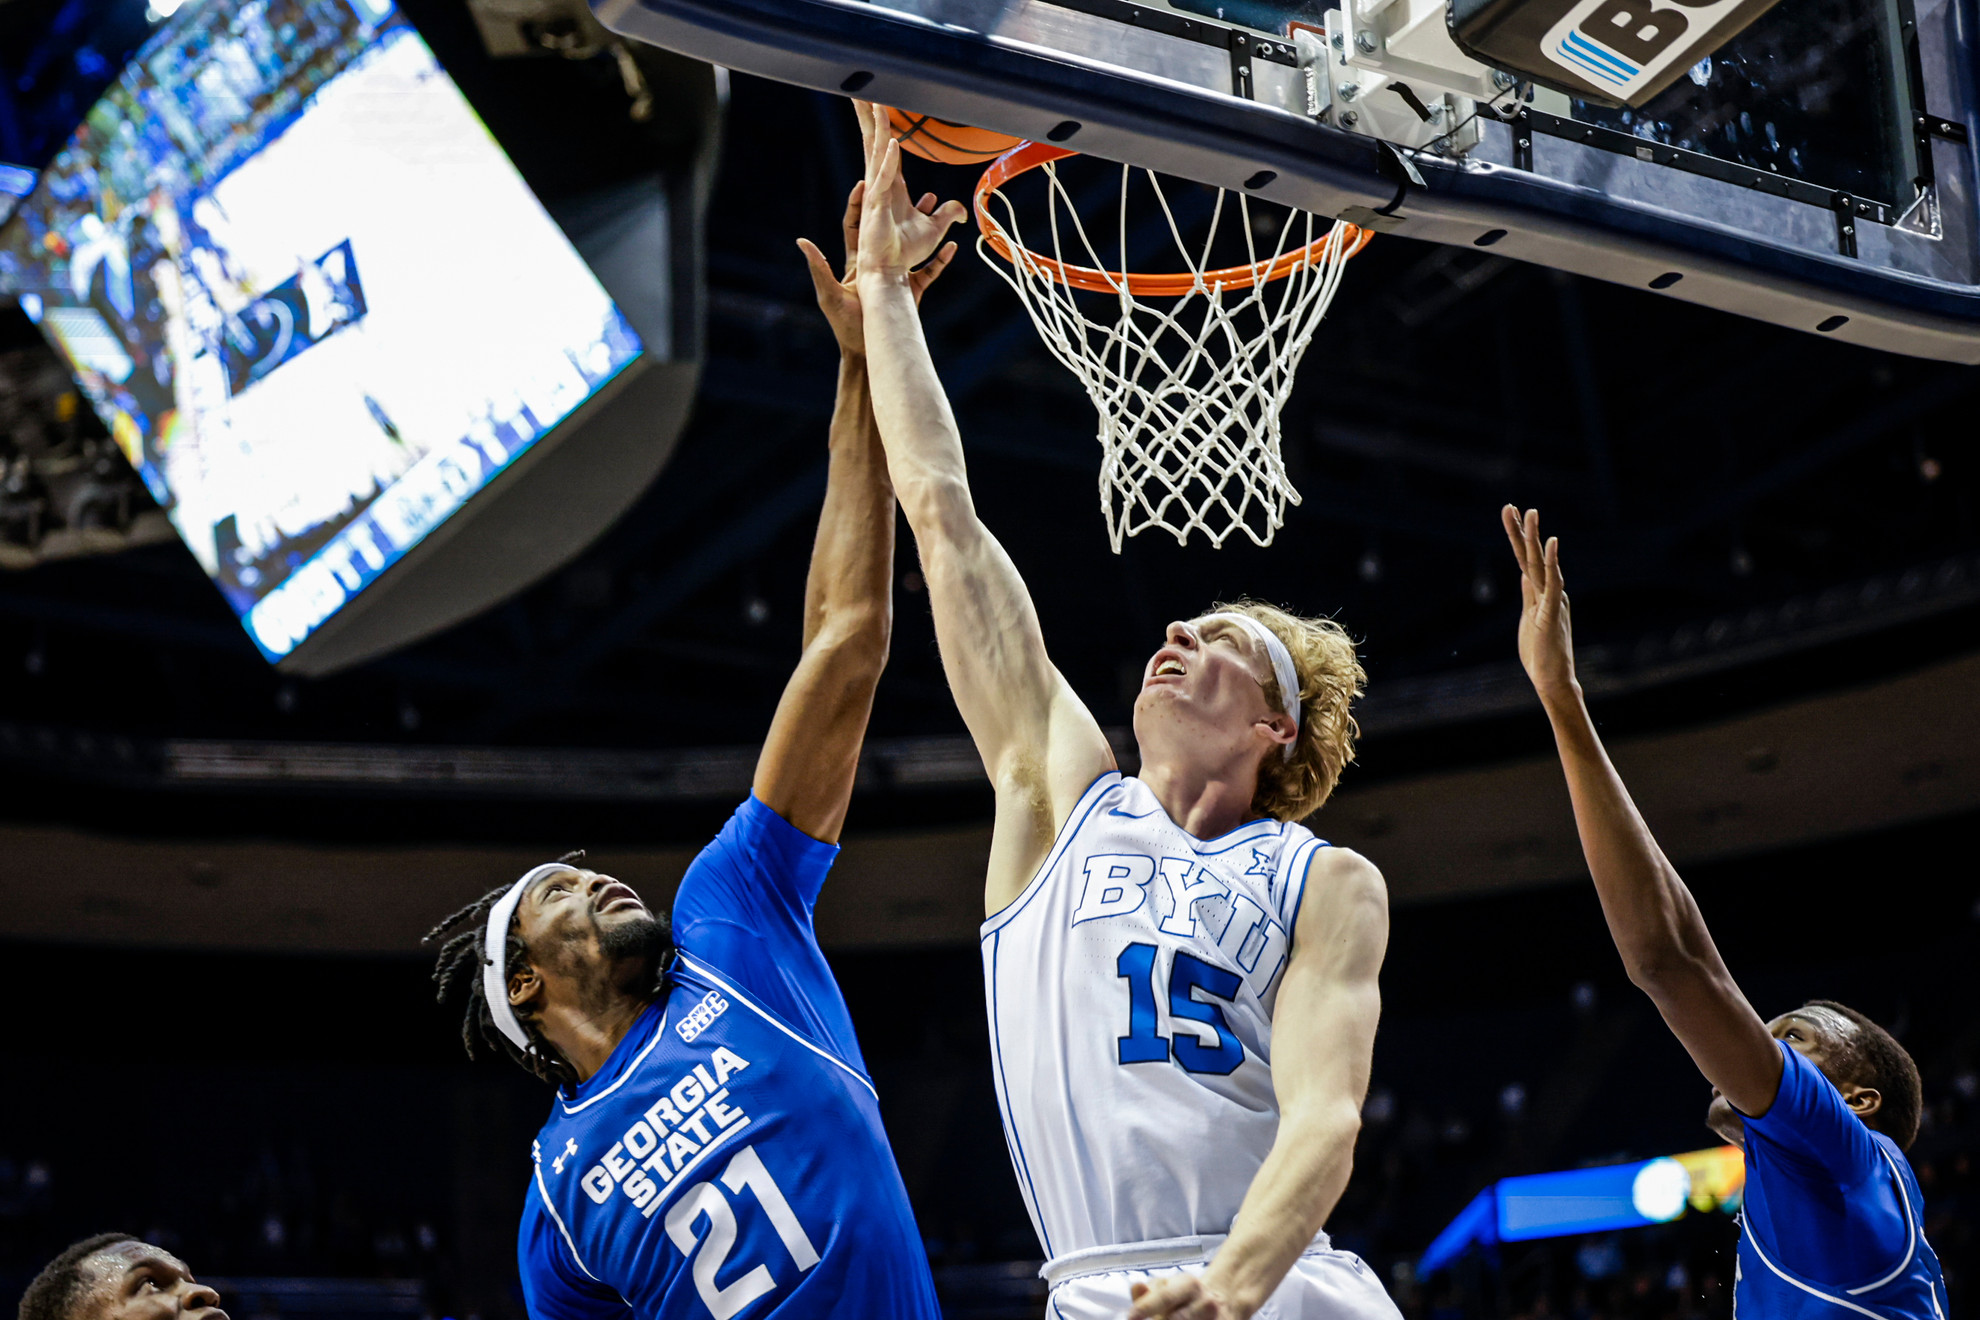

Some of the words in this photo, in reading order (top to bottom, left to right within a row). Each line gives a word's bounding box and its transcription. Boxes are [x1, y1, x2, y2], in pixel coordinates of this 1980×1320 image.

[1579, 0, 1722, 66] B
[1072, 853, 1287, 999] BYU
[675, 990, 730, 1043] SBC
[1116, 941, 1245, 1076] 15
[581, 1045, 750, 1205] GEORGIA
[622, 1087, 745, 1209] STATE
[664, 1145, 821, 1320] 21
